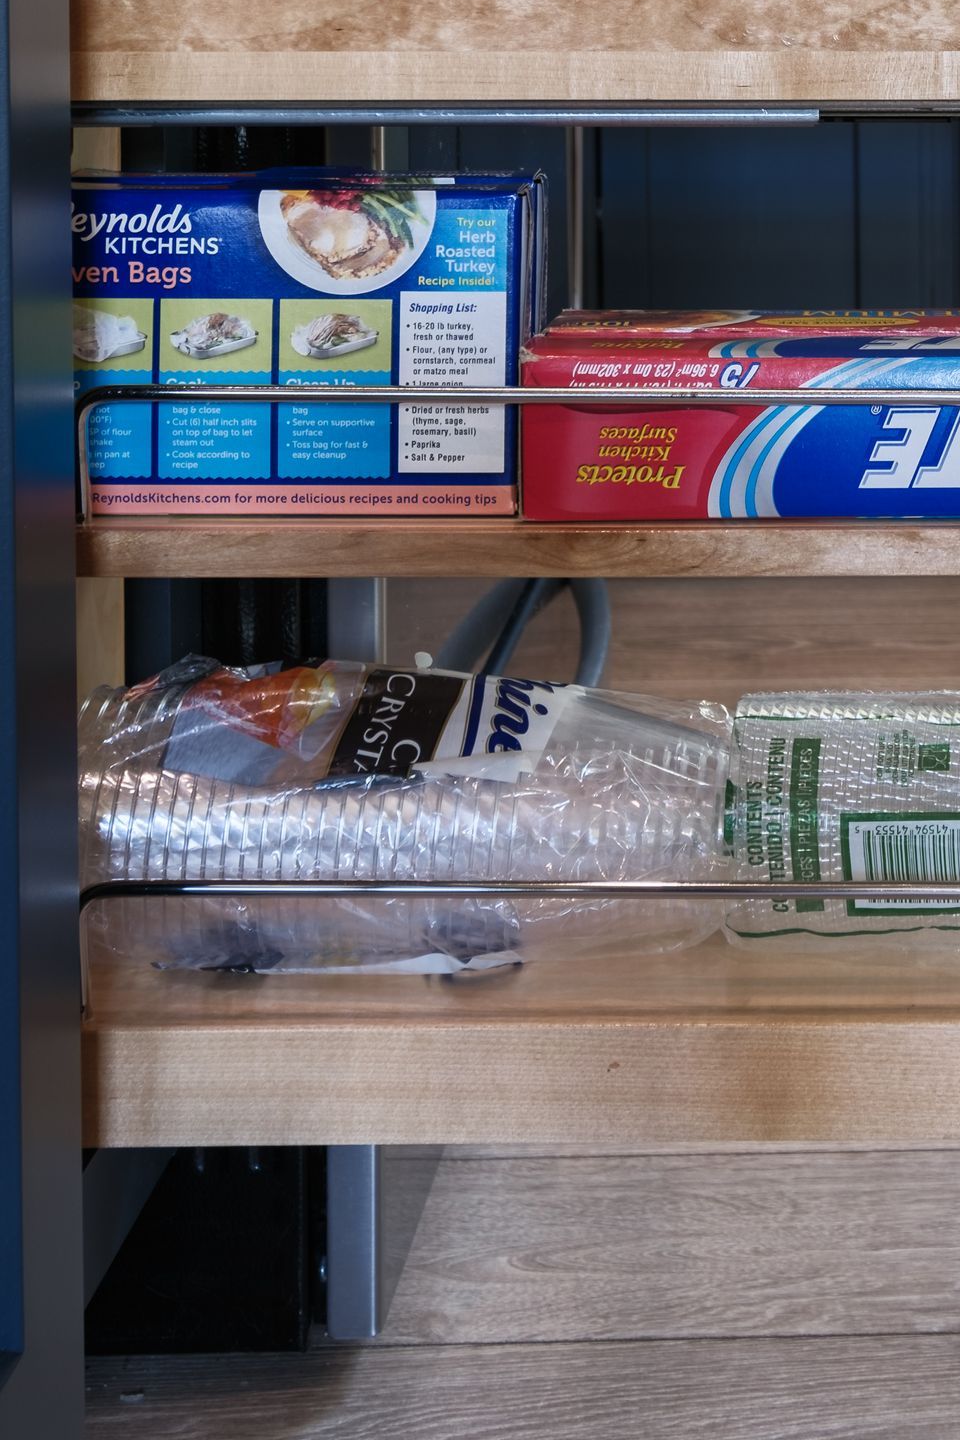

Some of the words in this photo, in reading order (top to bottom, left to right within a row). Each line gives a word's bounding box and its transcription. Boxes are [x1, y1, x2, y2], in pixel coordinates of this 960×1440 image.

[72, 203, 193, 242] eynolds
[456, 217, 474, 229] Try
[477, 218, 496, 227] our
[459, 231, 496, 243] Herb
[105, 237, 220, 255] KITCHENS
[435, 245, 496, 258] Roasted
[445, 260, 495, 275] Turkey
[72, 266, 119, 283] ven
[128, 261, 192, 290] Bags
[418, 276, 455, 288] Recipe
[458, 276, 495, 287] Inside!
[409, 303, 453, 314] Shopping
[456, 303, 478, 313] List:
[413, 322, 435, 331] 16-20
[437, 322, 445, 331] lb
[446, 323, 474, 333] turkey,
[413, 333, 433, 341] fresh
[446, 333, 474, 341] thawed
[412, 346, 436, 355] Flour,
[438, 346, 455, 356] (any
[457, 346, 477, 357] type)
[413, 356, 456, 366] cornstarch,
[459, 356, 496, 365] cornmeal
[424, 367, 446, 375] matzo
[448, 366, 469, 375] meal
[572, 361, 618, 378] 302mm)
[623, 364, 630, 375] x
[632, 362, 675, 377] (23.0m
[719, 362, 760, 388] 75
[412, 406, 432, 414] Dried
[445, 406, 465, 414] fresh
[467, 406, 489, 414] herbs
[172, 418, 187, 426] Cut
[189, 418, 201, 427] (6)
[203, 418, 218, 426] half
[220, 418, 239, 426] inch
[241, 418, 257, 426] slits
[330, 419, 375, 428] supportive
[412, 417, 442, 426] (thyme,
[444, 418, 467, 427] sage,
[185, 429, 198, 438] top
[200, 428, 211, 436] of
[212, 428, 228, 438] bag
[242, 428, 253, 436] let
[412, 429, 451, 438] rosemary,
[454, 428, 477, 437] basil)
[599, 426, 679, 443] Surfaces
[411, 440, 440, 450] Paprika
[172, 450, 194, 458] Cook
[196, 450, 239, 460] according
[411, 454, 427, 462] Salt
[429, 454, 435, 462] &
[437, 454, 465, 463] Pepper
[599, 445, 671, 462] Kitchen
[172, 461, 198, 469] recipe
[575, 464, 687, 490] Protects
[92, 493, 231, 506] ReynoldsKitchens.com
[234, 493, 252, 504] for
[255, 495, 288, 504] more
[291, 493, 347, 504] delicious
[349, 494, 393, 507] recipes
[396, 493, 419, 504] and
[422, 493, 471, 507] cooking
[474, 494, 497, 507] tips
[767, 737, 787, 806] CONTENU
[747, 781, 763, 866] CONTENTS
[875, 824, 908, 835] 41553
[915, 824, 948, 835] 41594
